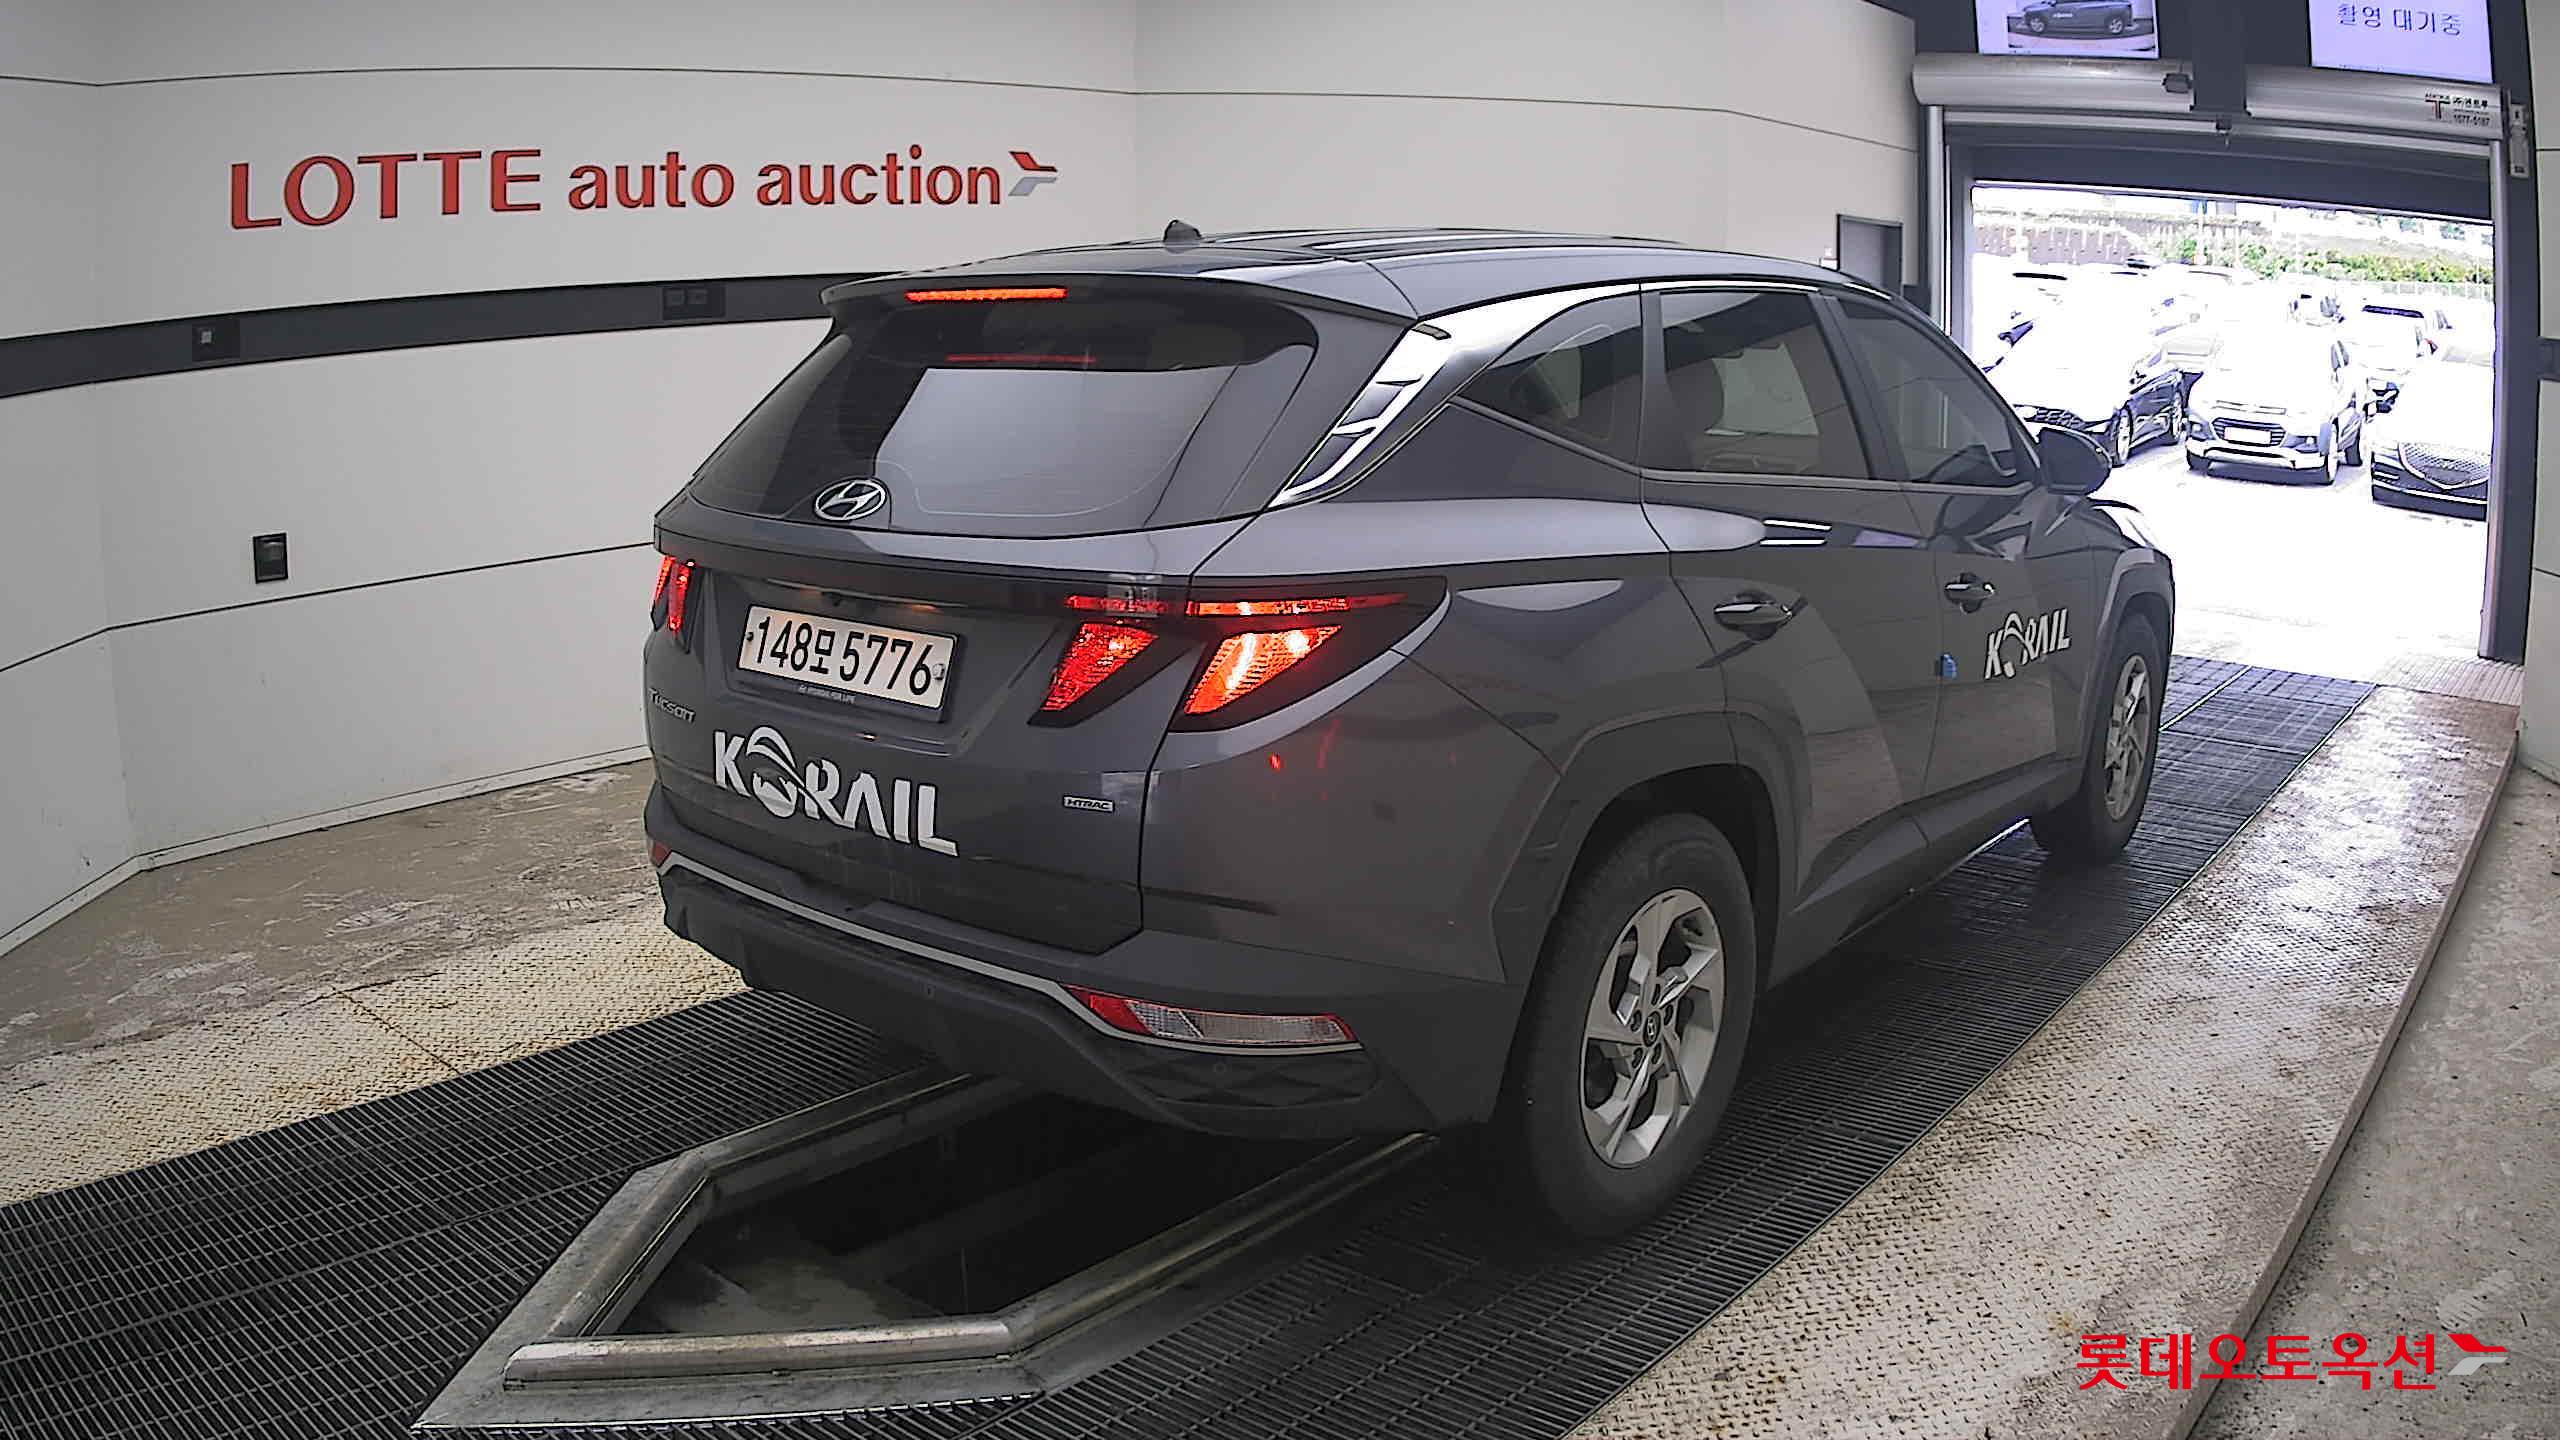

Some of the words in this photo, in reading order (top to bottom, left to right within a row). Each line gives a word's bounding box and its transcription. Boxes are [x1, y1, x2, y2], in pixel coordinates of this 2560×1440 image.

[2393, 8, 2461, 36] 대기중
[230, 148, 542, 230] LOTTE
[568, 150, 735, 210] auto
[756, 143, 1001, 206] auction
[1984, 607, 2072, 681] KORAIL
[712, 725, 959, 857] KORAIL
